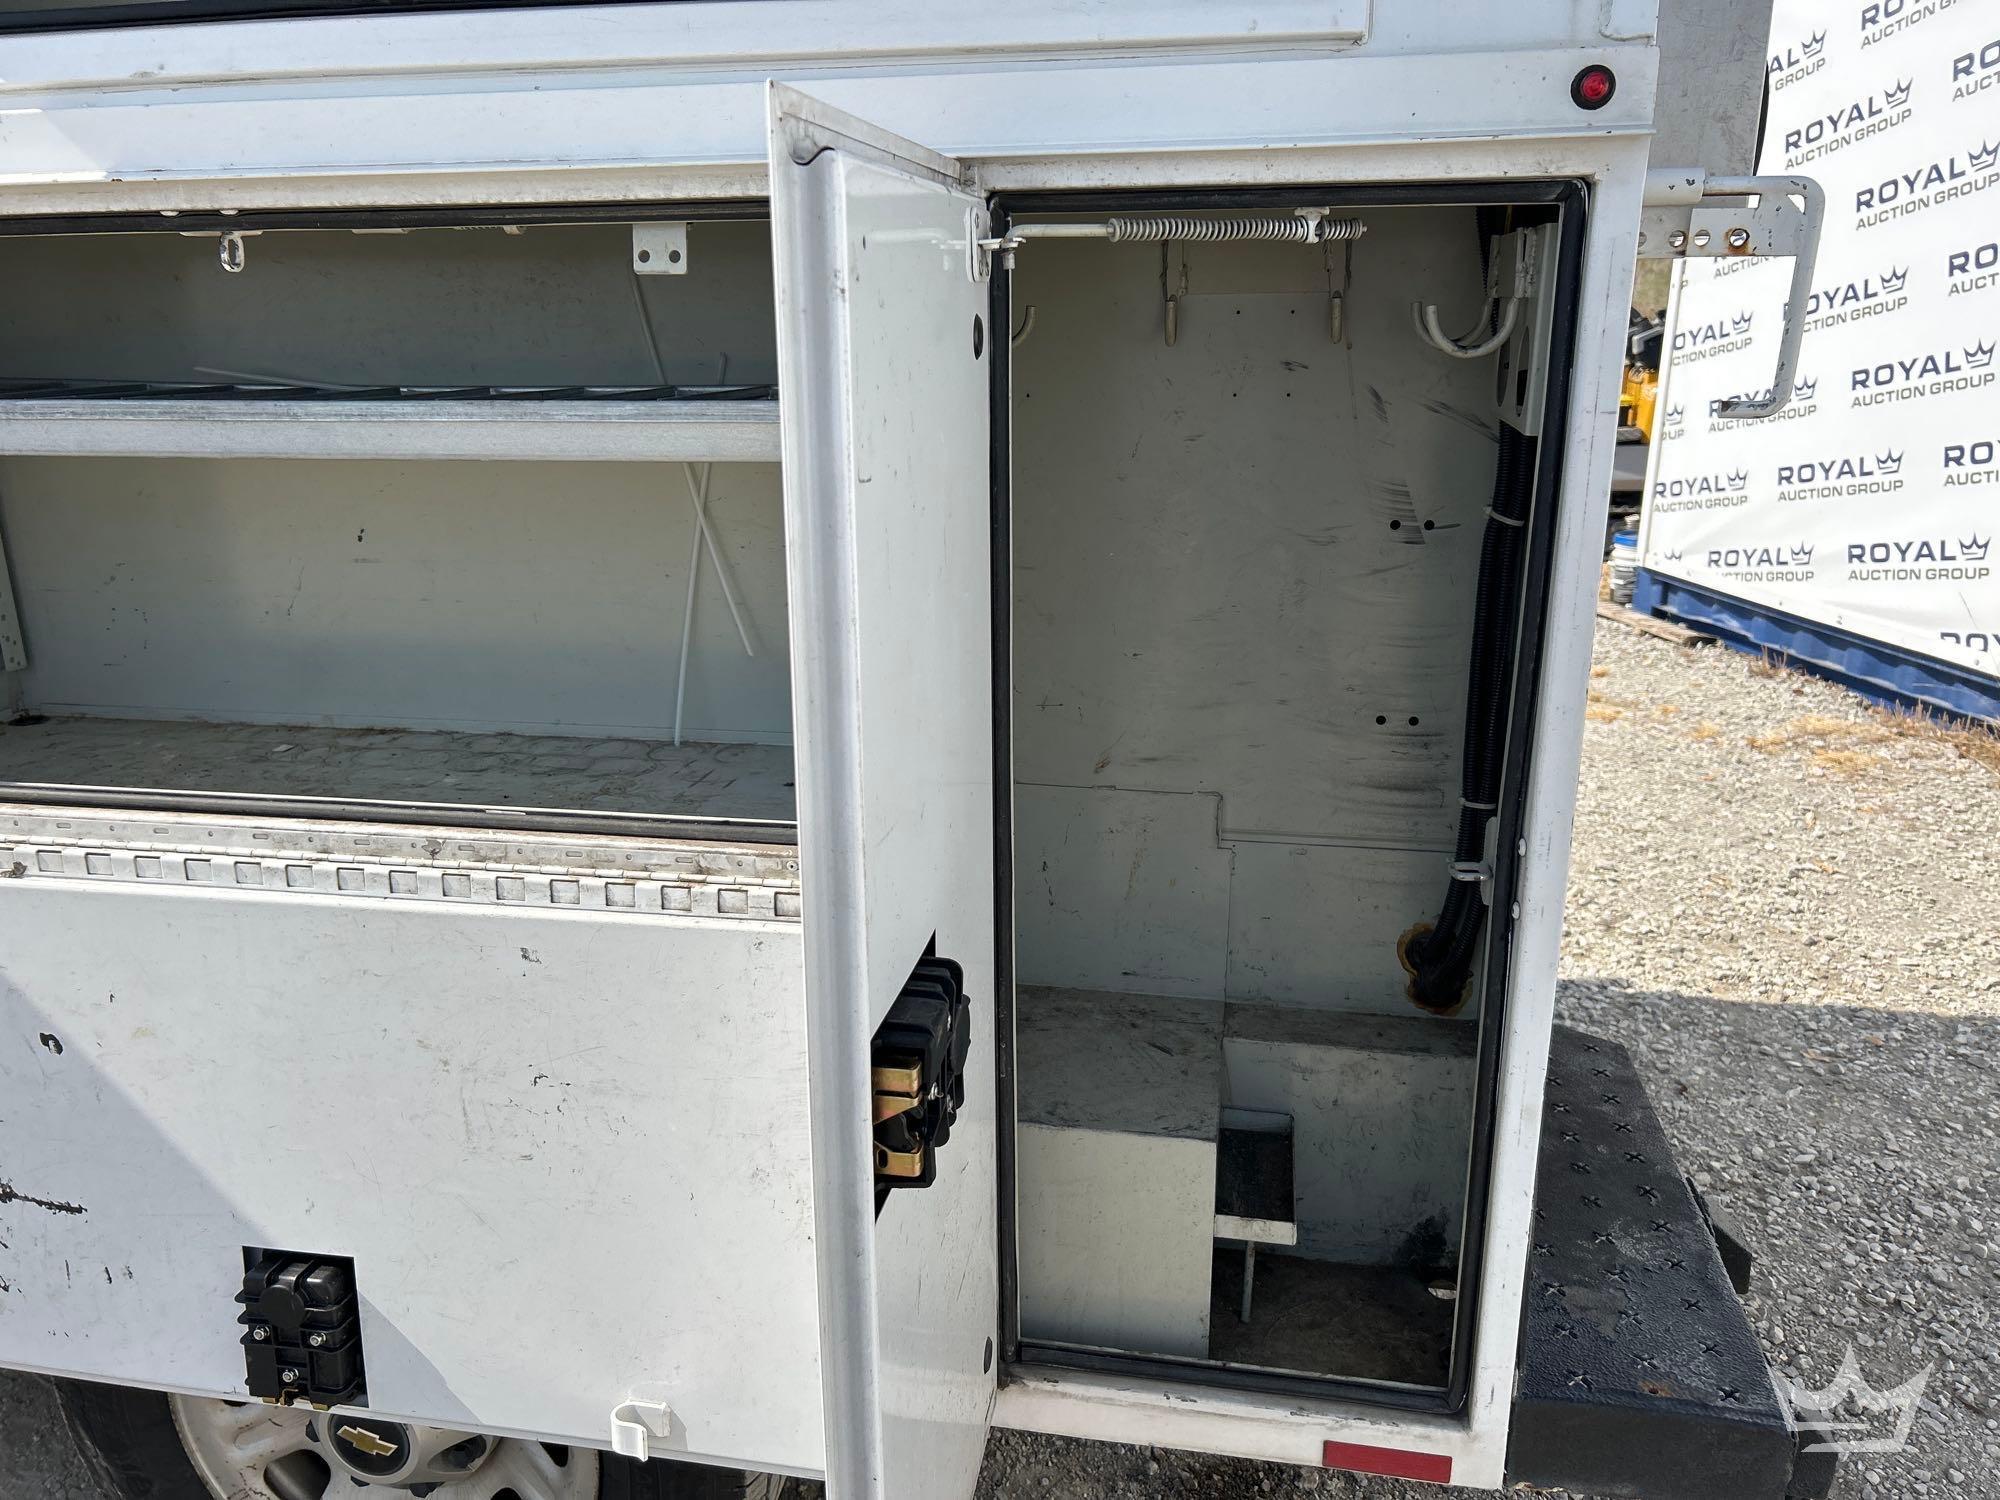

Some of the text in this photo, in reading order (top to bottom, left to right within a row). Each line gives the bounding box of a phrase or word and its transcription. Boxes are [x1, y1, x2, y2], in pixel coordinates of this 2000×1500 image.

[1861, 2, 1935, 49] AUCTION
[1775, 57, 1826, 91] GROUP
[1785, 96, 1883, 154] ROYAL
[1785, 108, 1912, 170] AUCTION GROUP
[1856, 157, 1966, 213] ROYAL
[1856, 172, 2000, 231] AUCTION GROUP
[1784, 278, 1878, 321] OYAL
[1803, 296, 1907, 334] CTION GROUP
[1672, 337, 1753, 367] CTION GROUP
[1673, 321, 1730, 351] OYAL
[1852, 351, 1962, 391] ROYAL
[1851, 372, 1996, 408] AUCTION GROUP
[1654, 475, 1726, 499] ROYAL
[1777, 457, 1874, 486] ROYAL
[1653, 496, 1748, 513] AUCTION GROUP
[1777, 479, 1904, 502] AUCTION GROUP
[1708, 547, 1789, 568] ROYAL
[1848, 540, 1957, 564] ROYAL
[1766, 571, 1815, 582] GROUP
[1848, 567, 1990, 581] AUCTION GROUP
